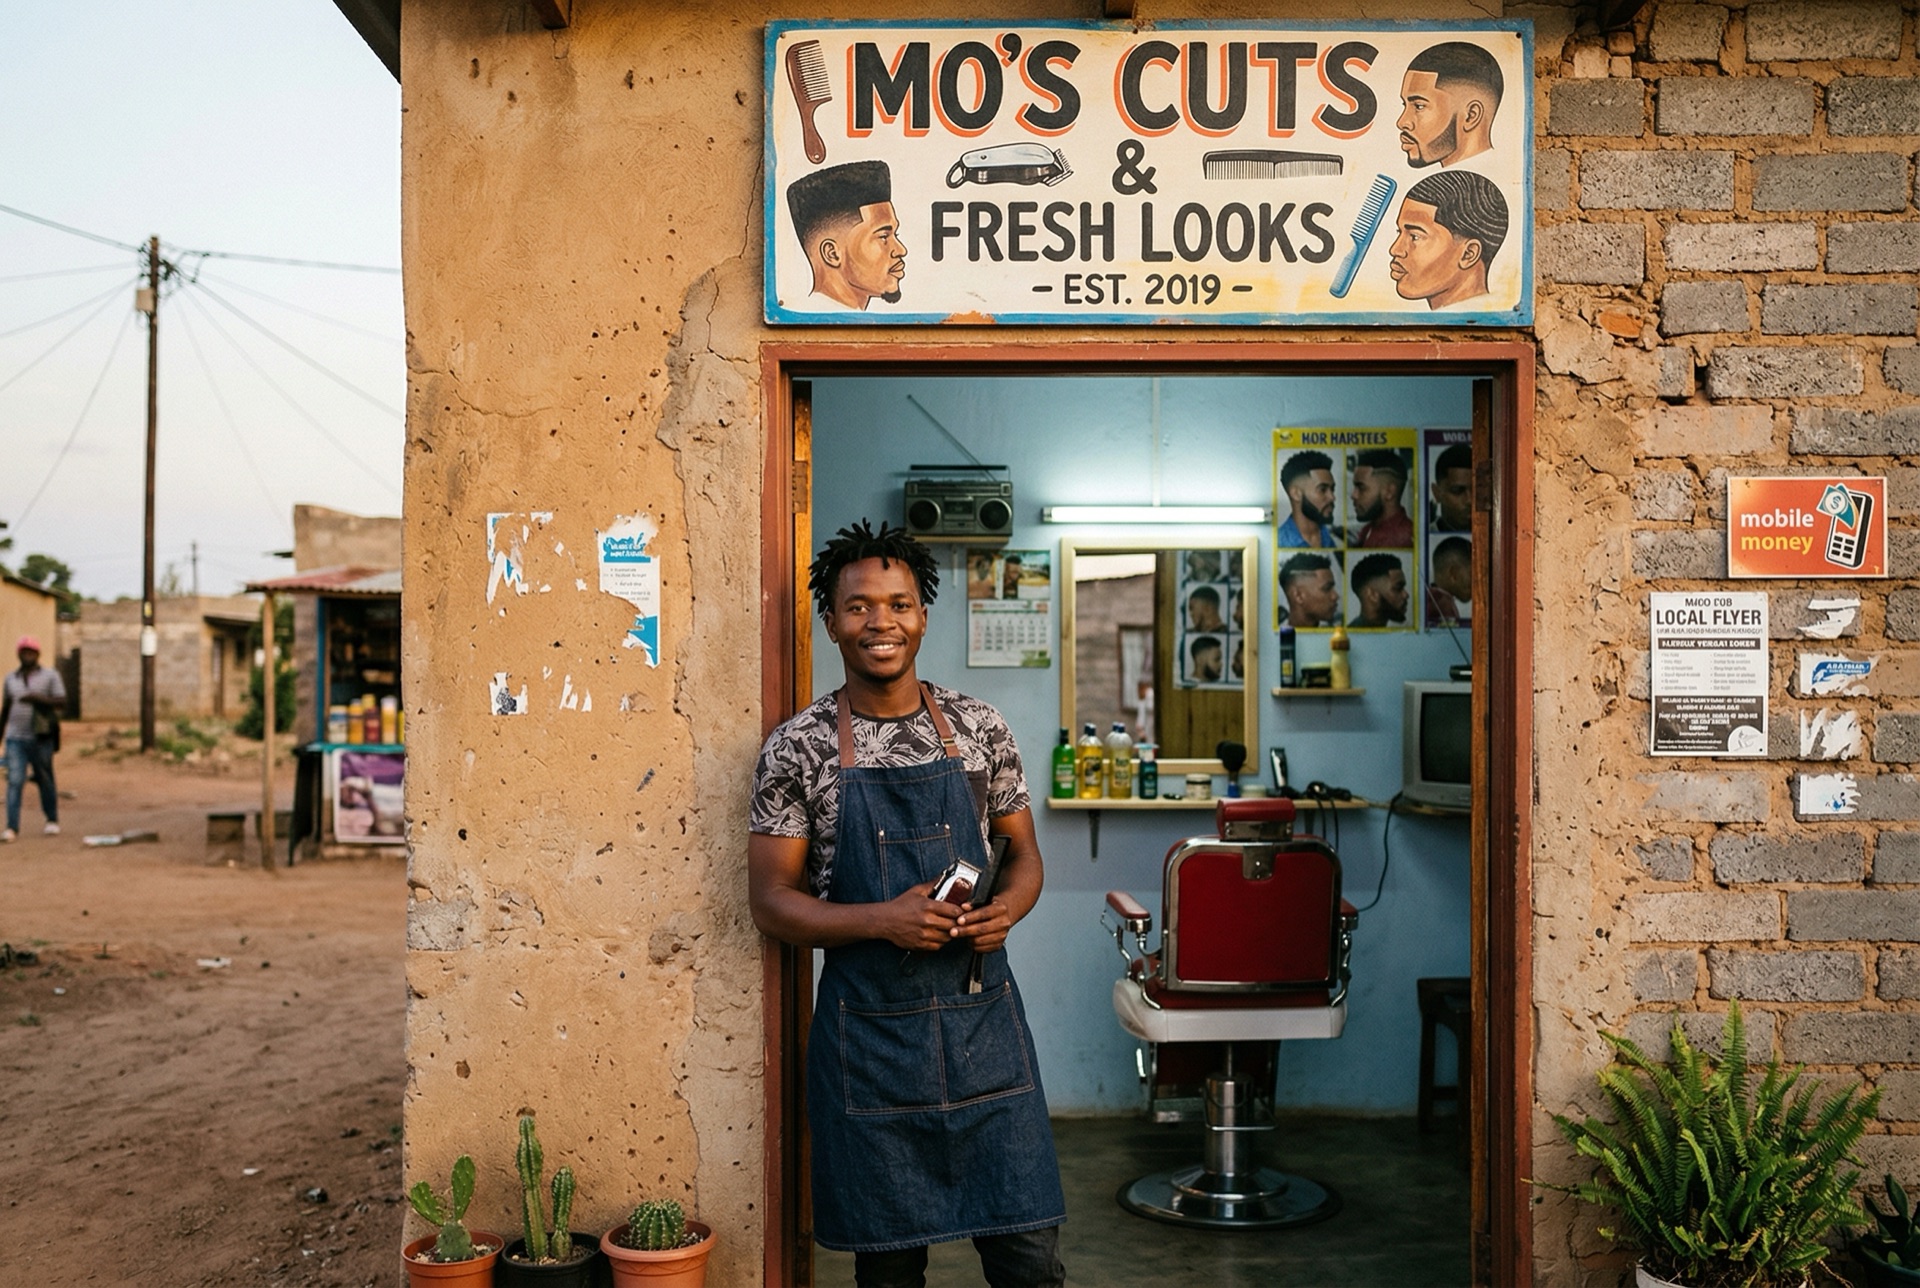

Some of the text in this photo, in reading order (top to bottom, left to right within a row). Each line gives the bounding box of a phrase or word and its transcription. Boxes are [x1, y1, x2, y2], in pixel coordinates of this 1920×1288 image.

[847, 33, 1378, 138] MO'S CUTS
[1112, 139, 1158, 195] &
[931, 201, 1335, 262] FRESH LOOKS
[1064, 273, 1132, 304] EST.
[1145, 273, 1221, 304] 2019
[1741, 508, 1814, 527] mobile
[1741, 536, 1814, 555] money
[1656, 609, 1762, 625] LOCAL FLYER
